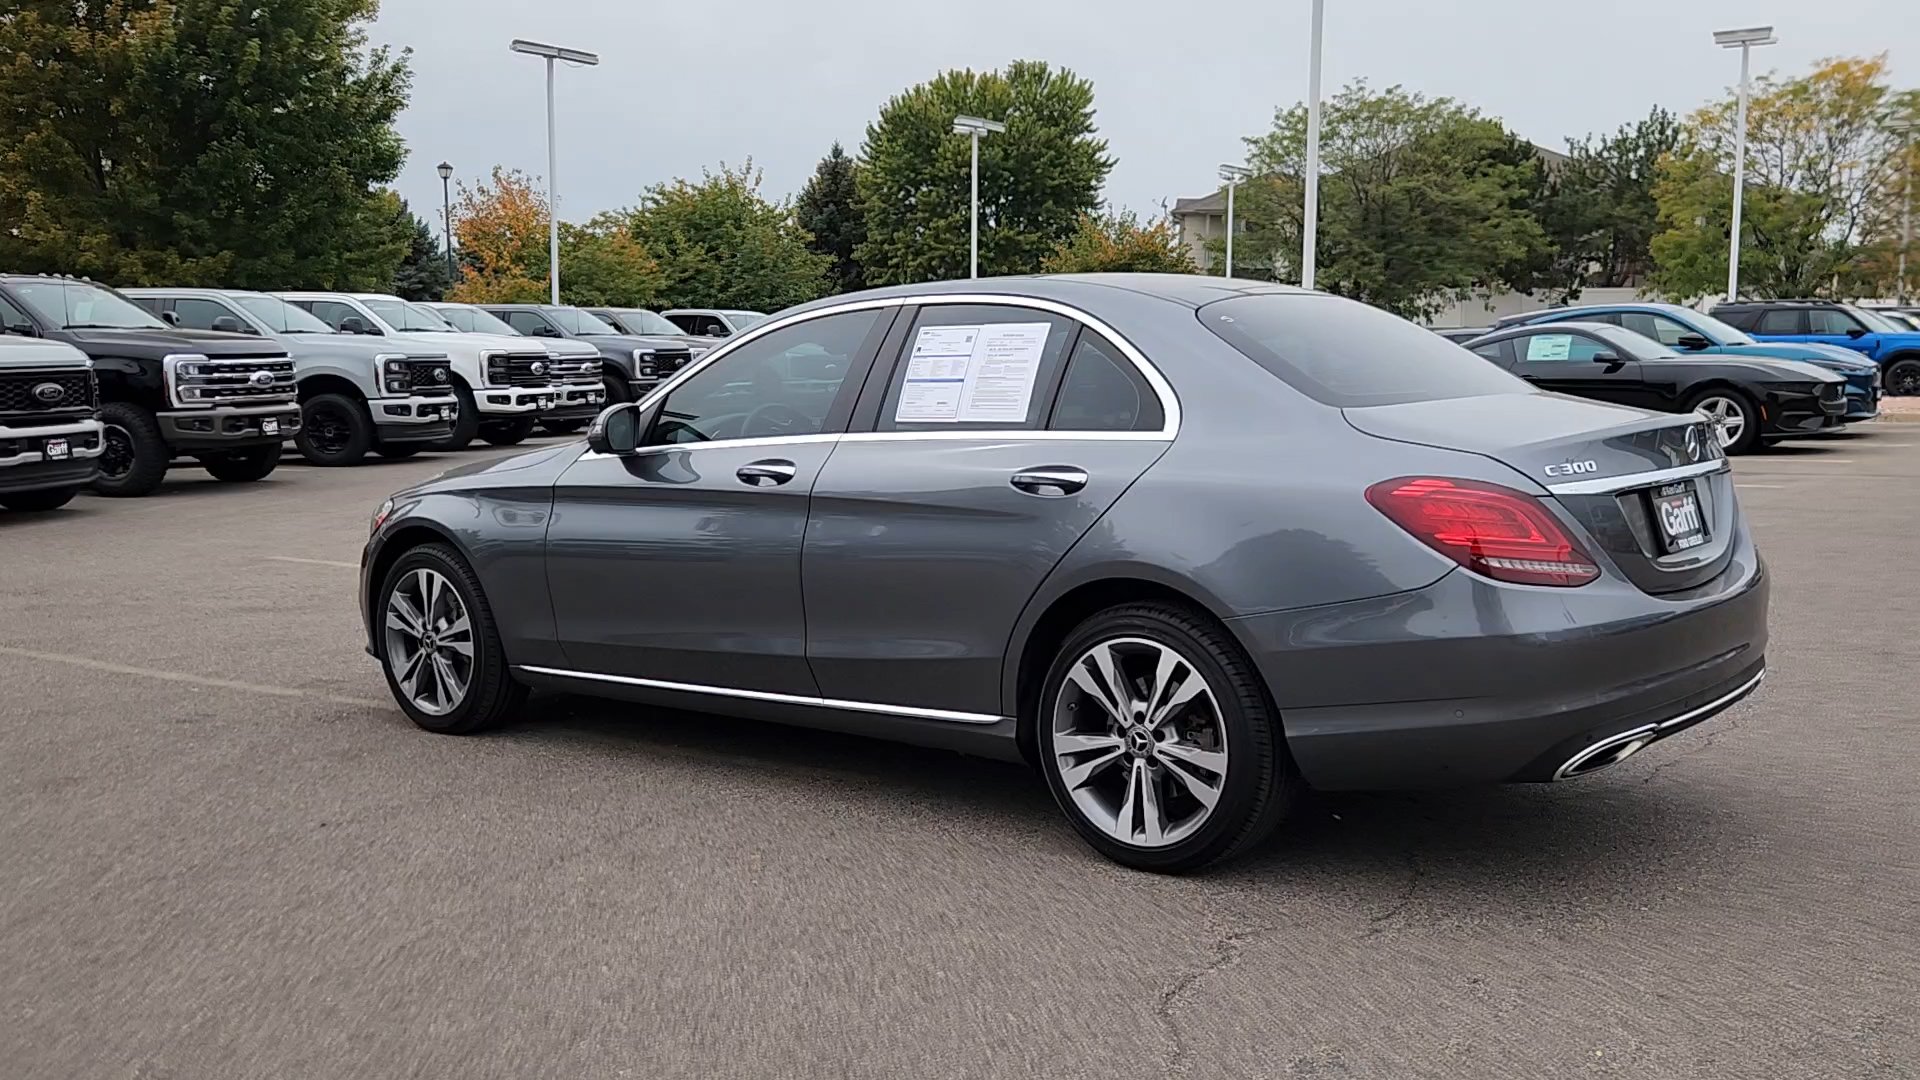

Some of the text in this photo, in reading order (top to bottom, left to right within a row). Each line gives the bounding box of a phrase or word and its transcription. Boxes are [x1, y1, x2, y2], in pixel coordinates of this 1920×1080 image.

[47, 442, 68, 456] Garff
[1544, 460, 1597, 476] C 300
[1661, 496, 1699, 536] Garff
